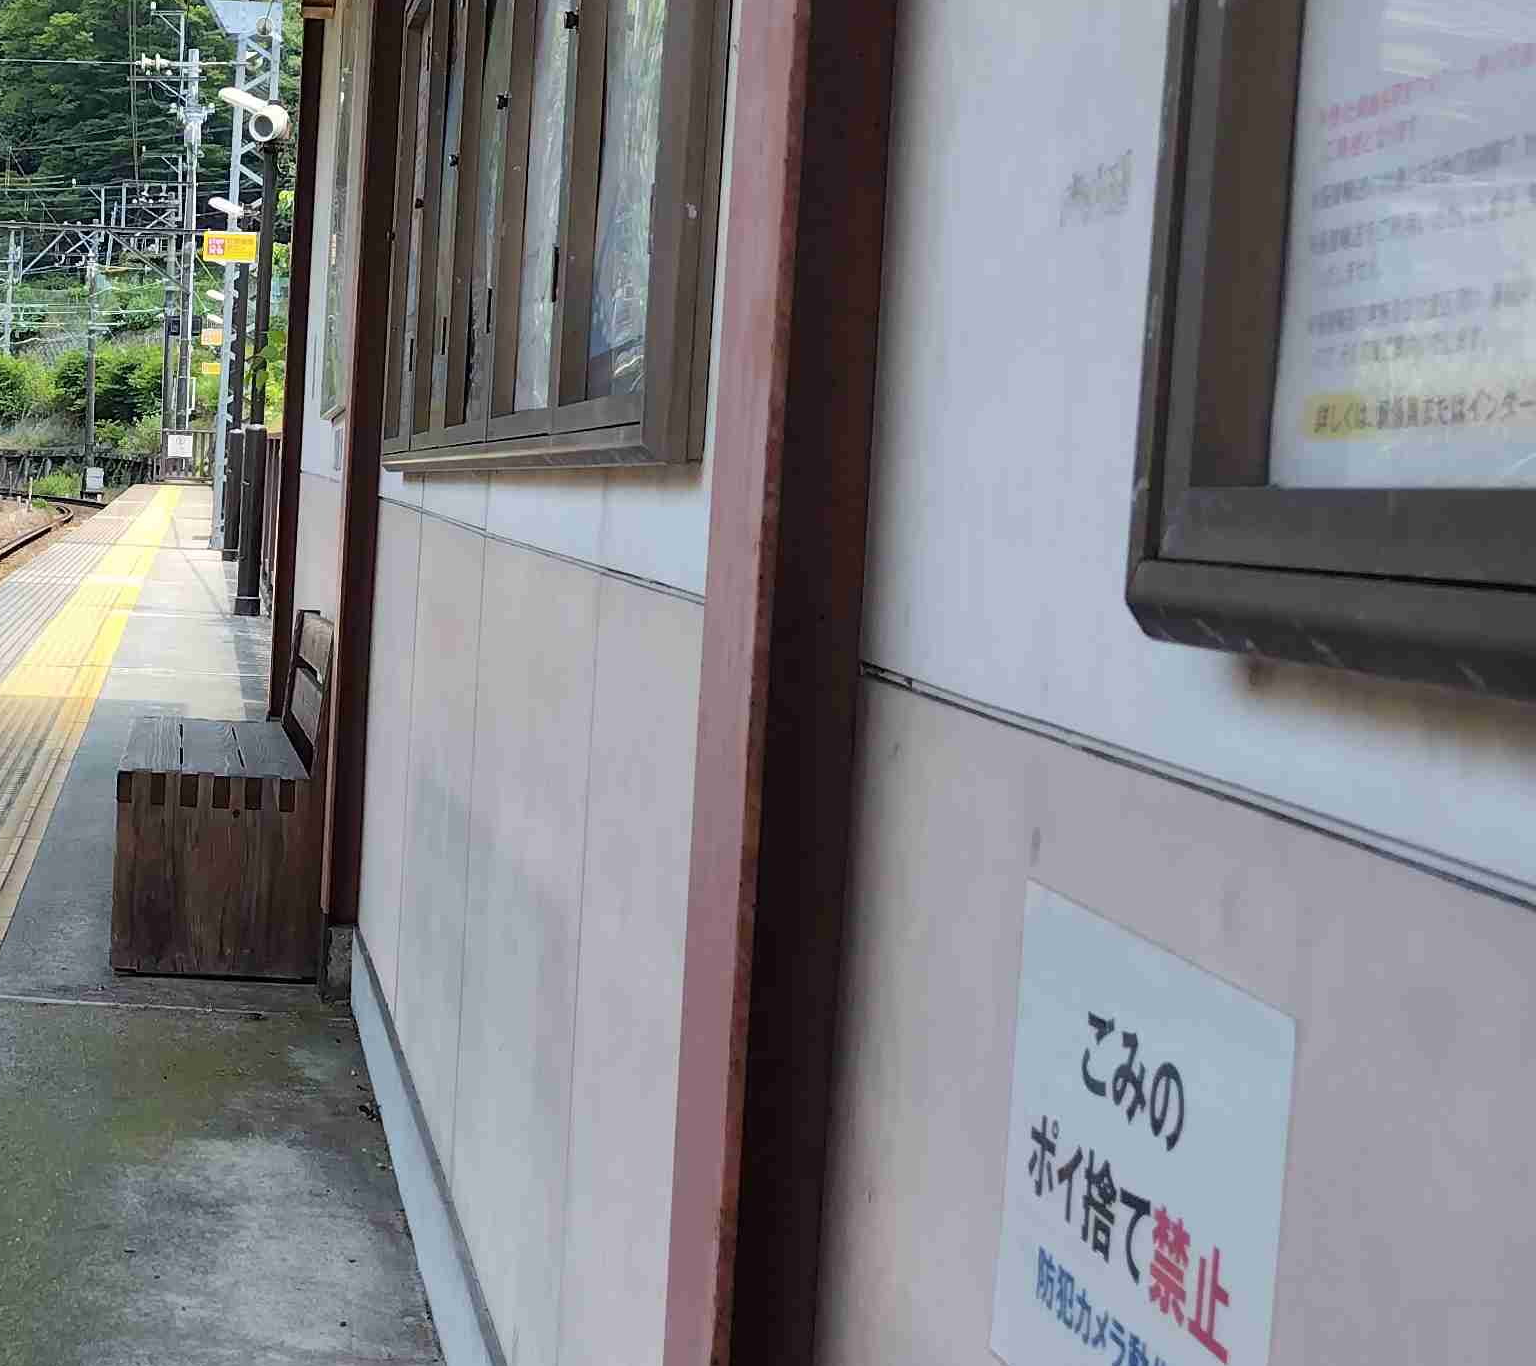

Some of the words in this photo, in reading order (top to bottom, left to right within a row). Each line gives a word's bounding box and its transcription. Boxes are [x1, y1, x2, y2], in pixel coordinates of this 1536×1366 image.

[1081, 1010, 1186, 1153] ごみの
[1027, 1113, 1231, 1365] ポイ捨て禁止
